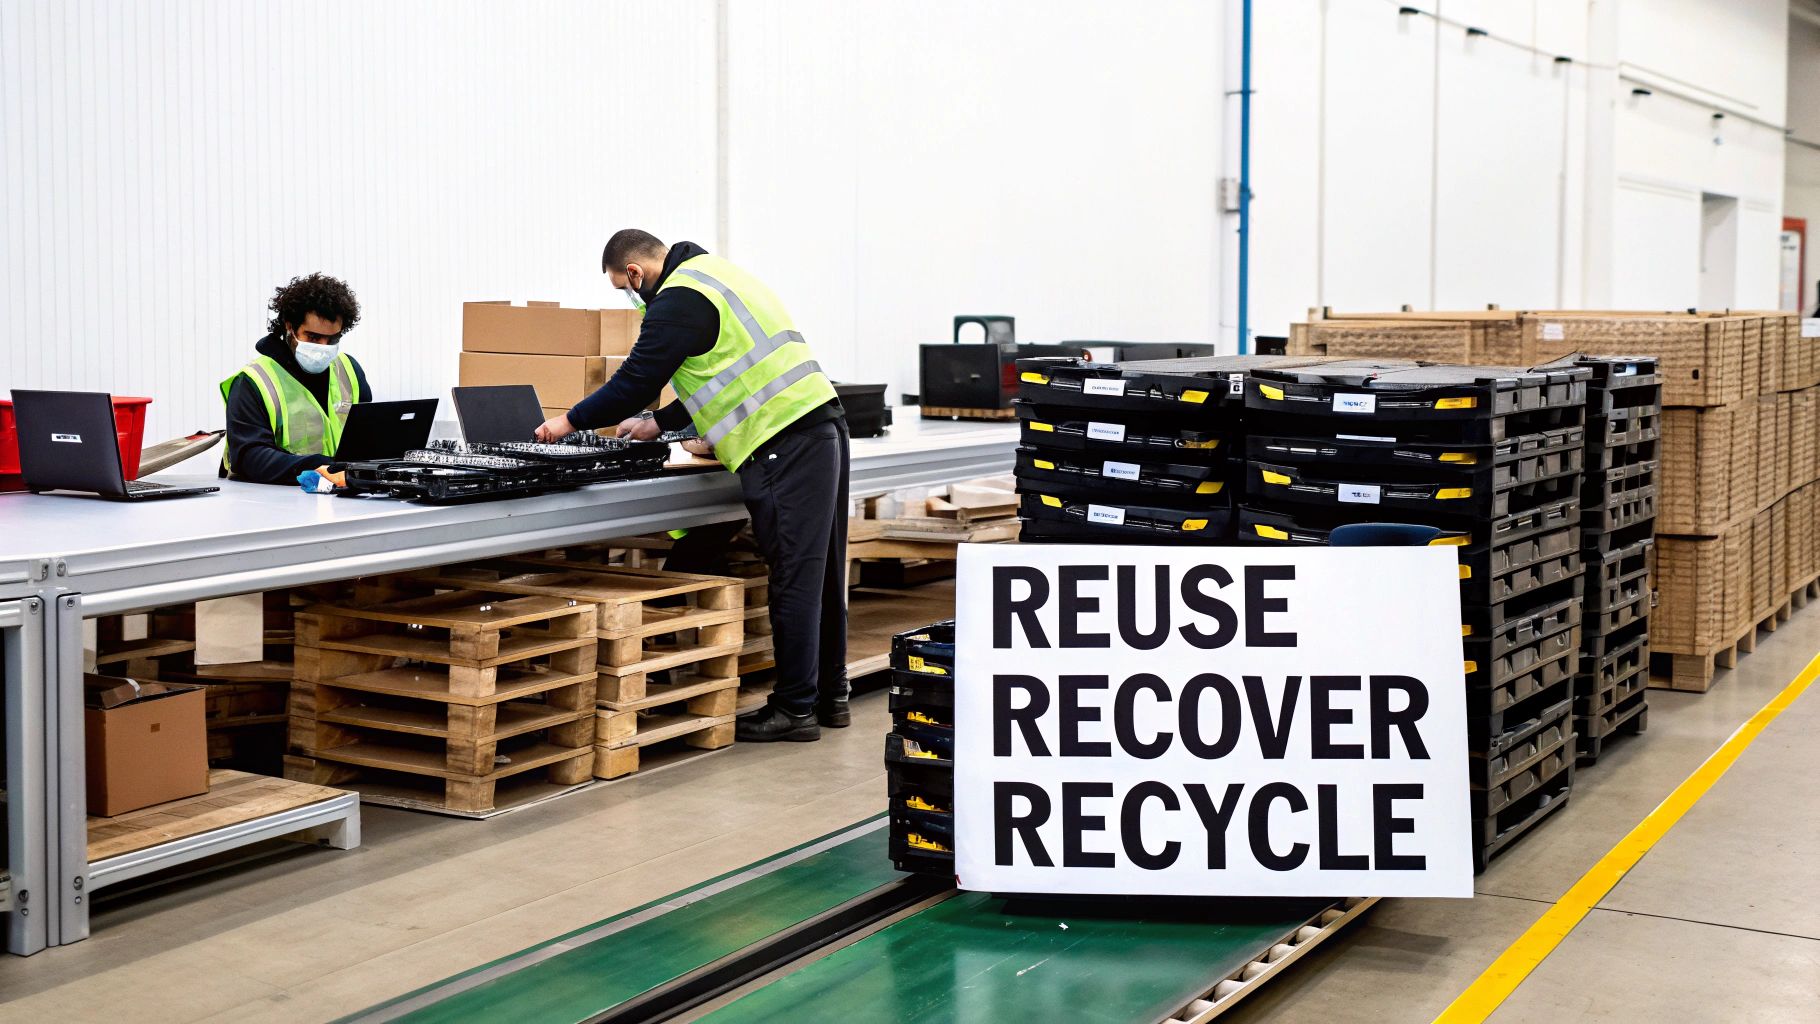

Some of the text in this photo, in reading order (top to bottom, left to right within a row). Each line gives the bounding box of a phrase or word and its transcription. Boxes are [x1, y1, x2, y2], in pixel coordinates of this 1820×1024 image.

[993, 564, 1297, 650] REUSE
[993, 673, 1430, 759] RECOVER
[994, 782, 1426, 871] RECYCLE
